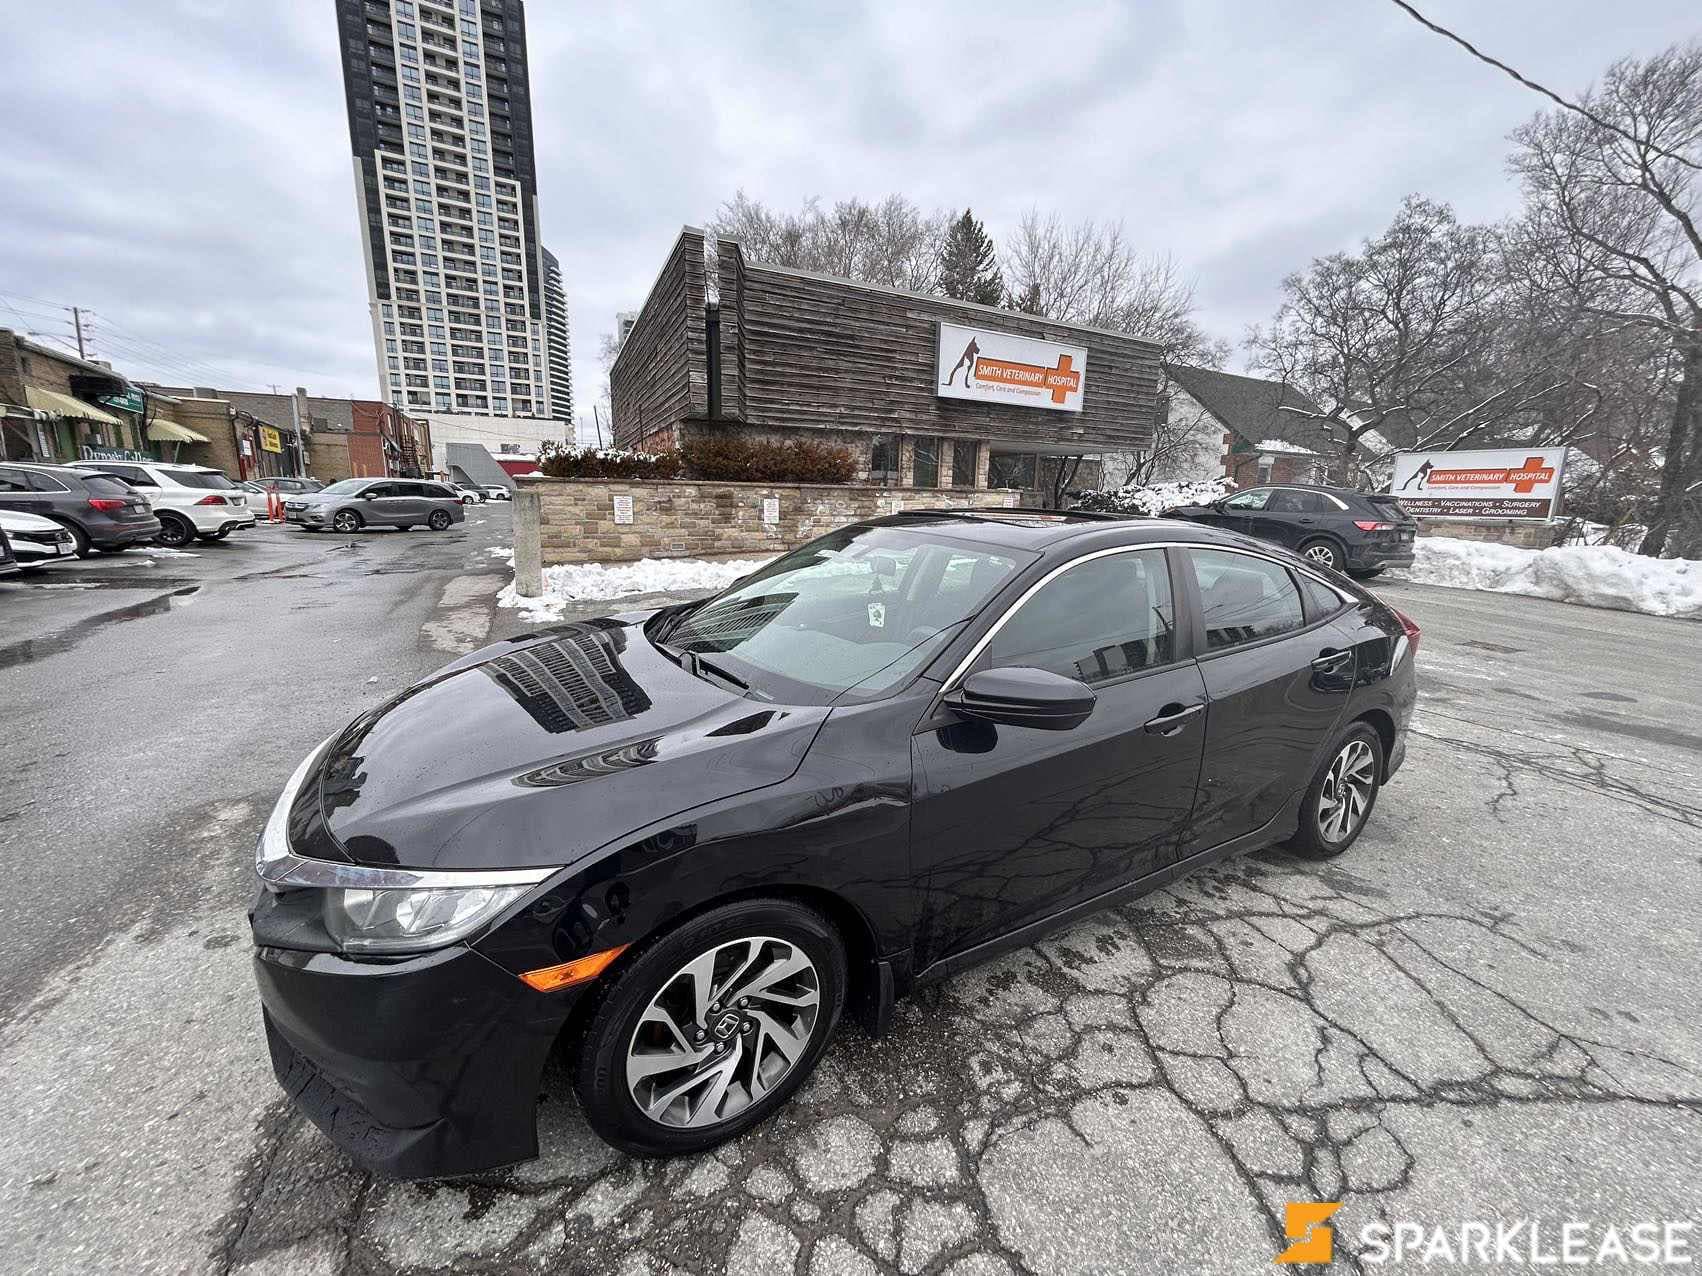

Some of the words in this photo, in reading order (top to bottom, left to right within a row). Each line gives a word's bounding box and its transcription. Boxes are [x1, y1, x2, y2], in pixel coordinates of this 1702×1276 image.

[977, 365, 1002, 378] SMITH
[1003, 367, 1044, 383] VETERINARY
[1047, 375, 1078, 387] HOSPITAL
[1457, 473, 1504, 481] VETERINARY
[1509, 472, 1550, 481] HOSPITAL
[1440, 499, 1493, 507] VACCINATIONS
[1502, 500, 1542, 508] SURGERY
[1481, 507, 1528, 515] GROOMING
